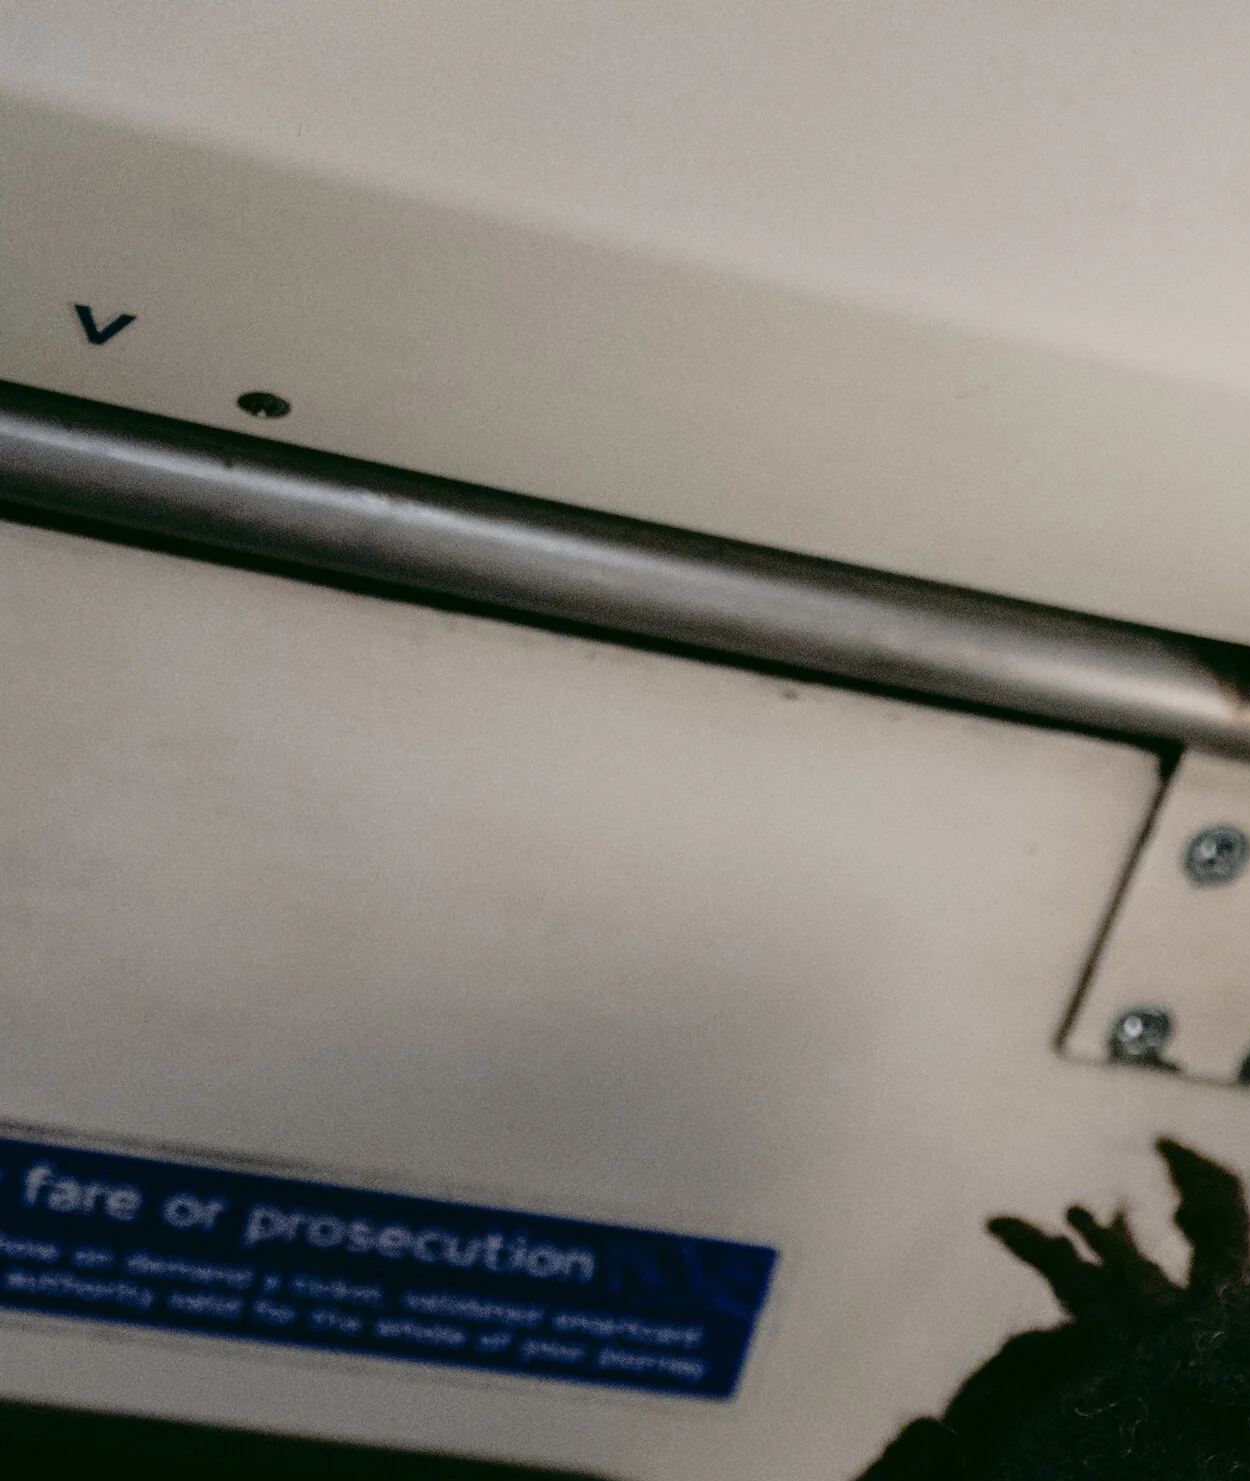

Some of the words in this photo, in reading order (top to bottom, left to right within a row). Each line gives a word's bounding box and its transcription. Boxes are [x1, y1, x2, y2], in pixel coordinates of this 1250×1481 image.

[25, 1162, 143, 1220] fare
[163, 1194, 226, 1230] or
[246, 1206, 597, 1282] prosecution
